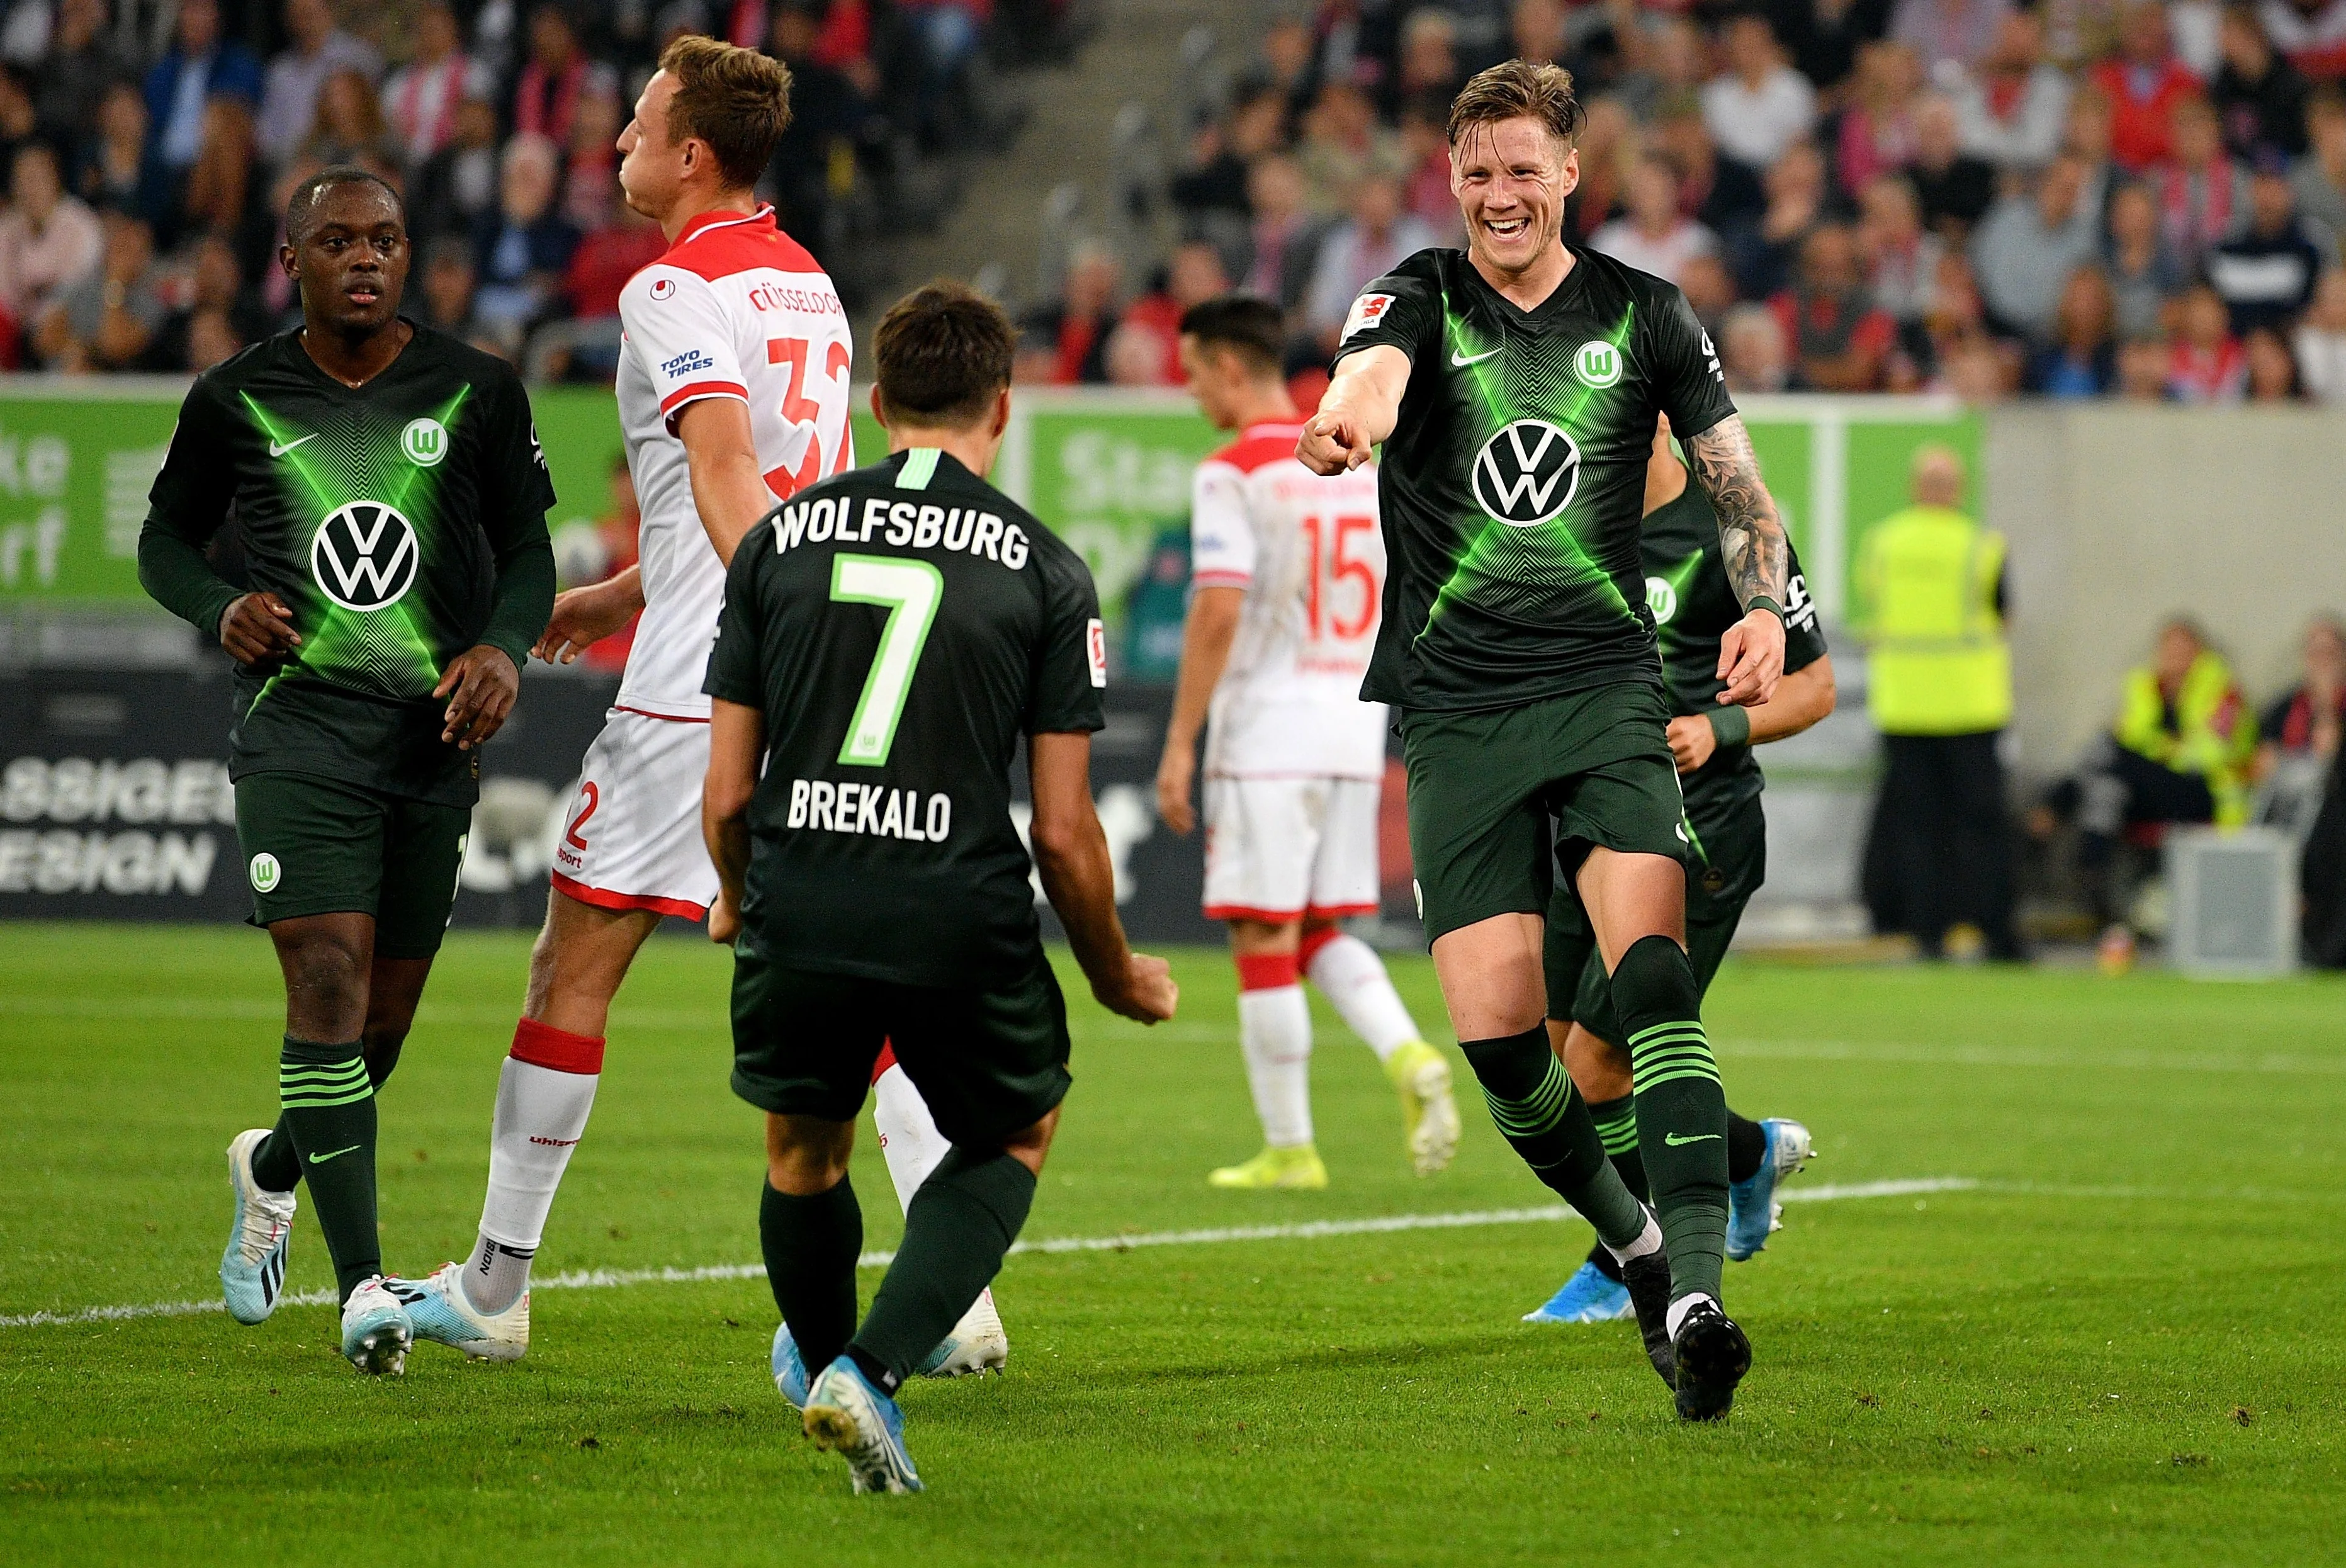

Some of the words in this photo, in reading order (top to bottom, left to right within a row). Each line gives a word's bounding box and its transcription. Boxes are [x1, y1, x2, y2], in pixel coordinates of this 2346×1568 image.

[748, 282, 845, 319] DÜSSELDOR
[668, 357, 713, 379] TIRES
[771, 496, 1030, 570] WOLFSBURG
[1300, 514, 1378, 642] 15
[829, 552, 944, 767] 7
[0, 757, 235, 823] SSIGE
[565, 781, 599, 852] 2
[787, 779, 951, 843] BREKALO
[558, 848, 583, 869] sport
